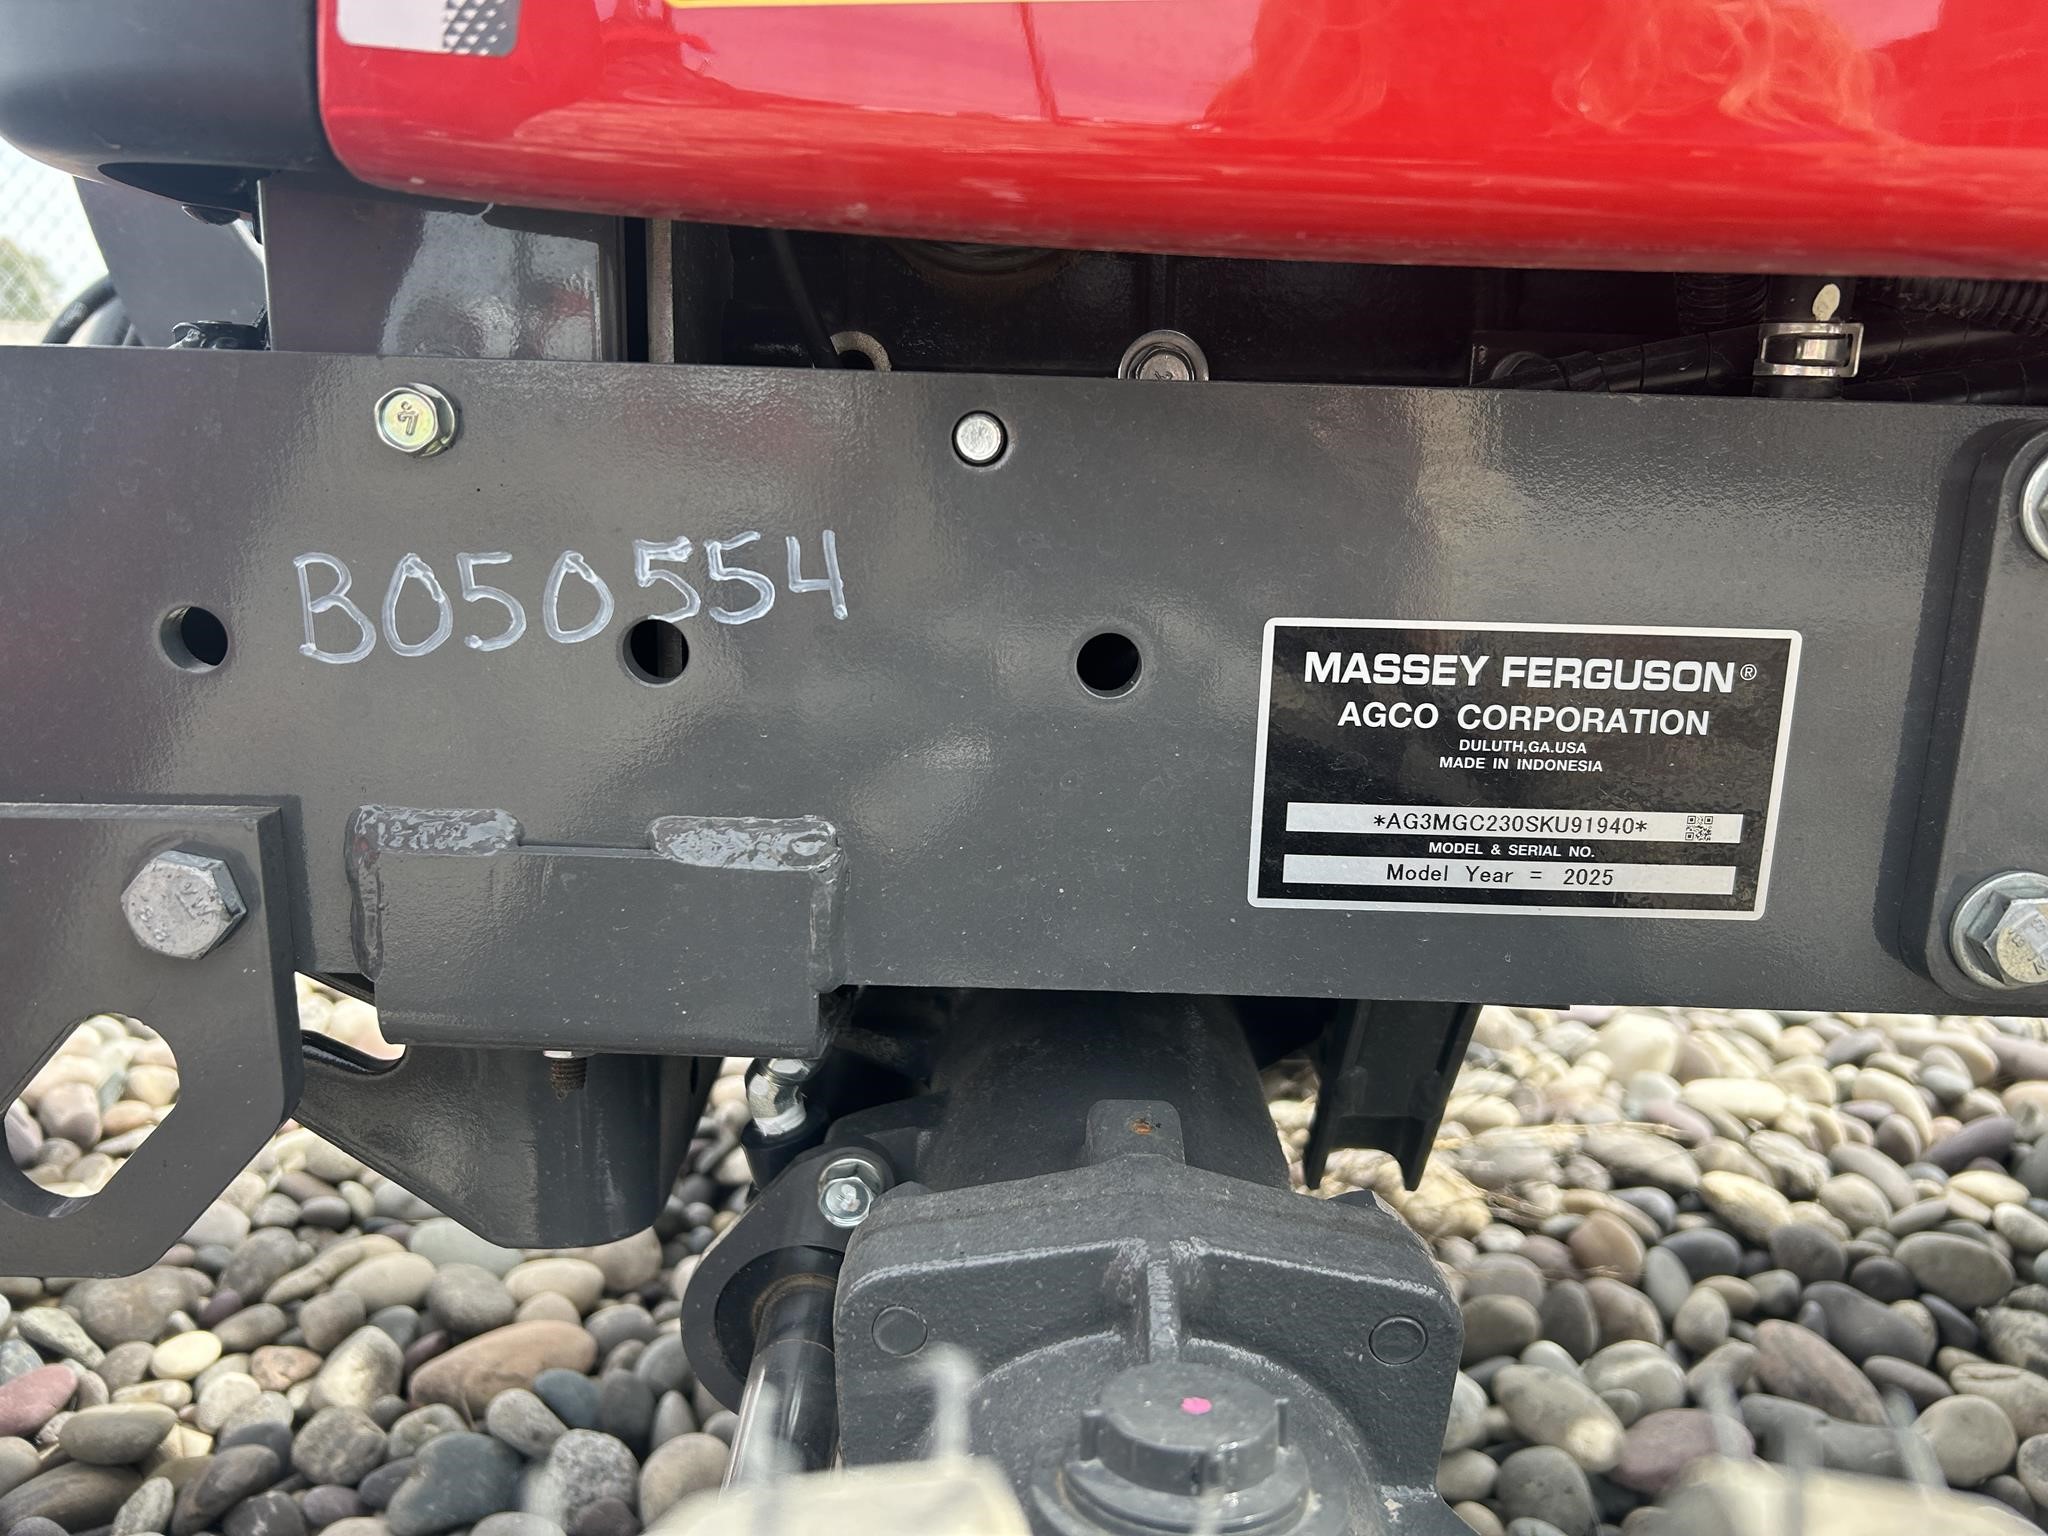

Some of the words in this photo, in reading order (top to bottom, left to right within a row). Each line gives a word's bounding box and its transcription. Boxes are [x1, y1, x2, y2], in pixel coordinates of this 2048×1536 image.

[294, 530, 848, 664] B050554
[1304, 651, 1490, 687] MASSEY
[1337, 701, 1439, 729] AGCO
[1457, 703, 1710, 735] CORPORATION
[1459, 739, 1588, 755] DULUTH,GA.USA
[1439, 756, 1486, 770] MADE
[1492, 758, 1509, 771] IN
[1516, 758, 1603, 773] INDONESIA
[1428, 841, 1484, 855] MODEL
[1490, 843, 1501, 856] &
[1508, 844, 1562, 857] SERIAL
[1568, 845, 1595, 858] NO.
[1386, 863, 1449, 882] Model
[1465, 865, 1514, 883] Year
[1562, 868, 1614, 886] 2025
